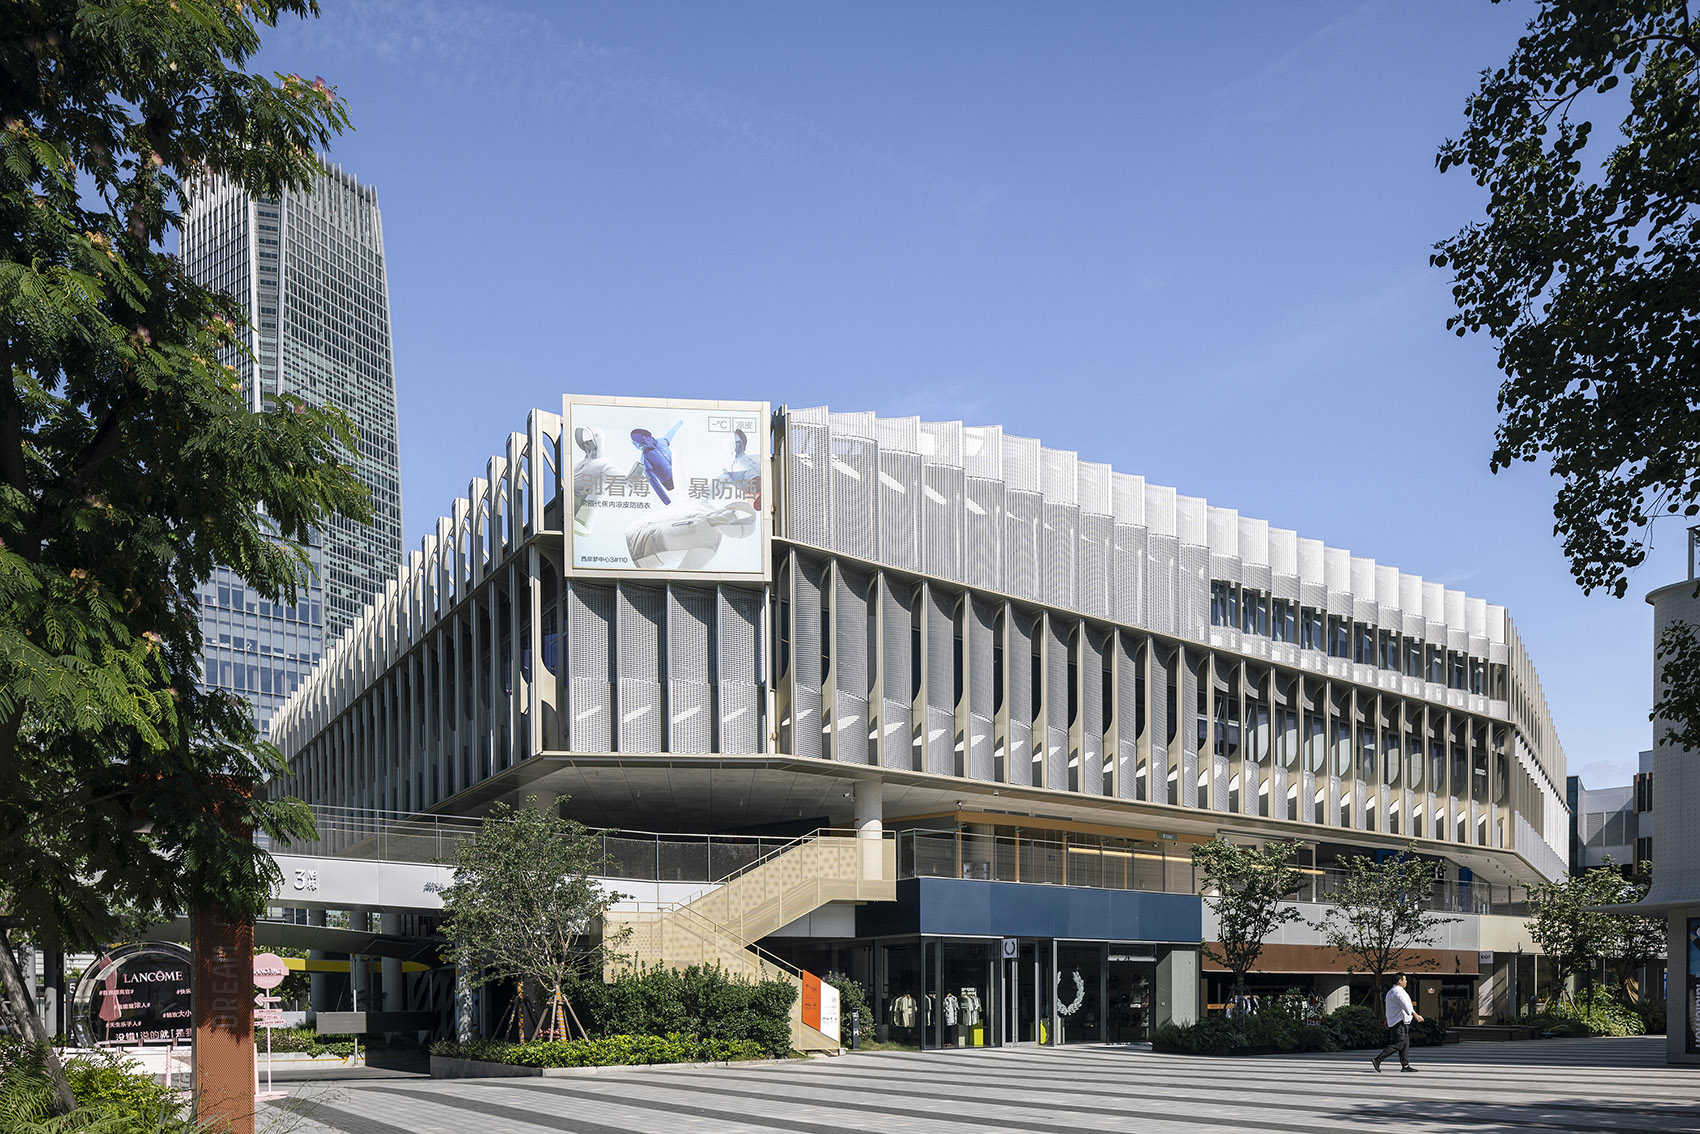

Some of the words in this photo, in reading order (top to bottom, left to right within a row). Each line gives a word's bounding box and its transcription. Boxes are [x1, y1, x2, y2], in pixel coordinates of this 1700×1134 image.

[688, 477, 757, 501] 暴防晒
[293, 869, 306, 891] 3
[124, 970, 184, 984] LANCÔME
